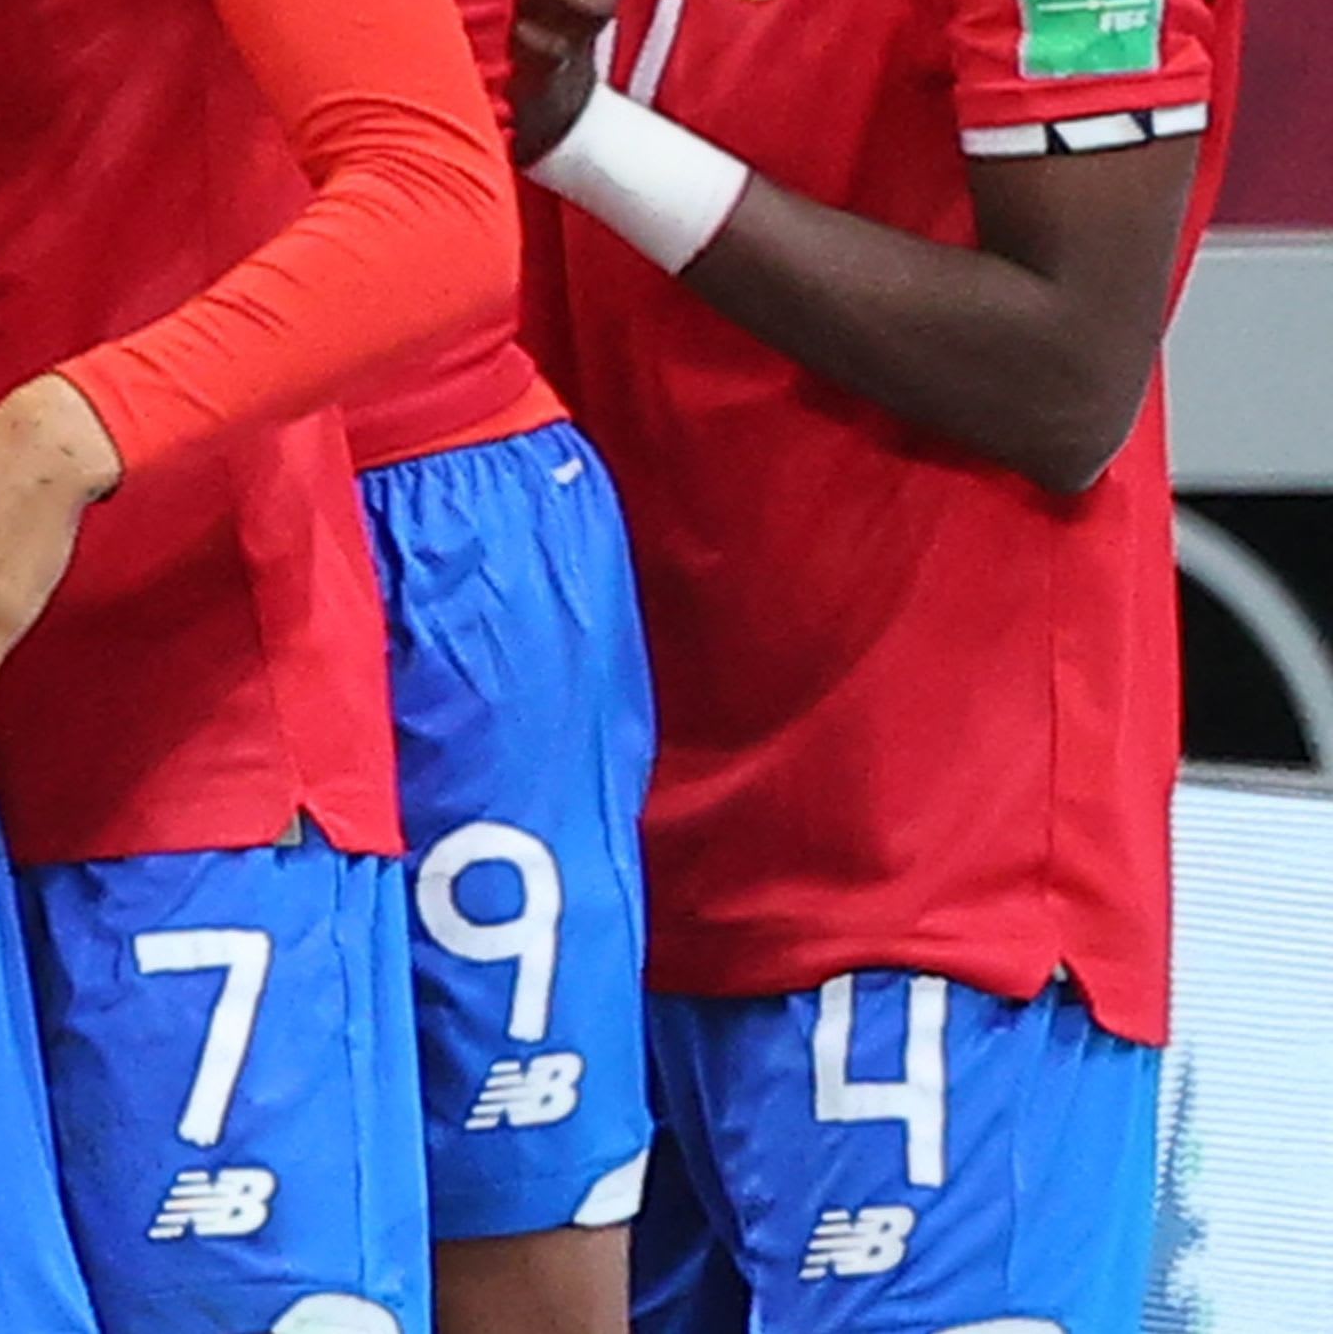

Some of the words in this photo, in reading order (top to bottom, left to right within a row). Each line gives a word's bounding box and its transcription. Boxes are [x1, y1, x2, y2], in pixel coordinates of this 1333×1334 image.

[134, 927, 272, 1147] 7
[416, 821, 564, 1042] 9
[813, 972, 949, 1189] 4
